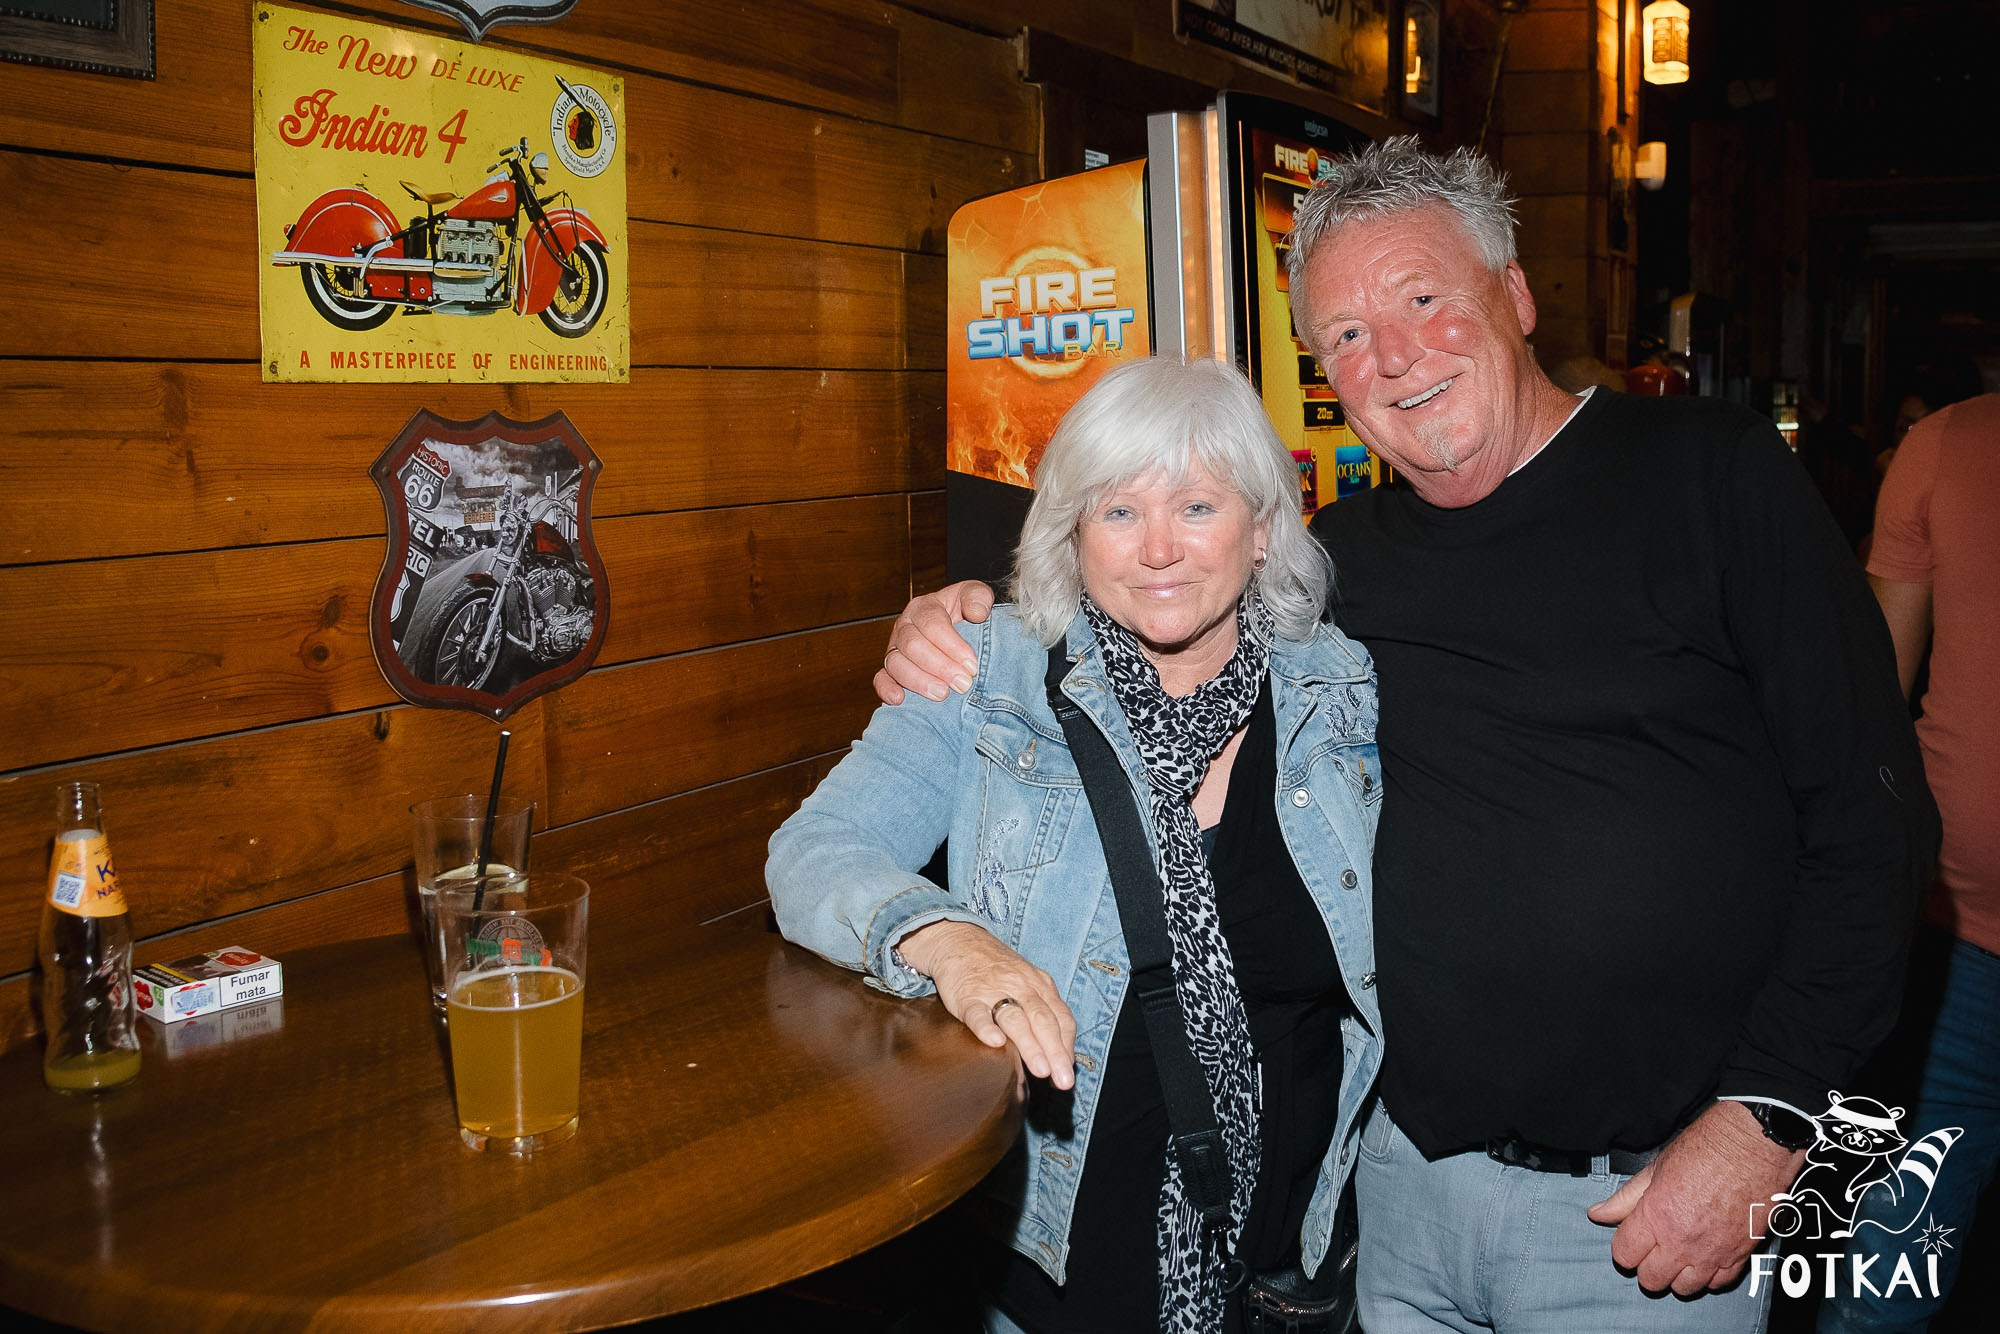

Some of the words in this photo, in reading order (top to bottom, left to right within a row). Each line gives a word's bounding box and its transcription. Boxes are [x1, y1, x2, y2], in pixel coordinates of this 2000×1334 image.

[283, 26, 329, 55] The
[337, 34, 417, 80] New
[466, 66, 525, 93] LUXE
[278, 89, 428, 158] Indian
[437, 108, 469, 164] 4
[1274, 143, 1309, 176] FIRE
[978, 267, 1118, 317] FIRE
[967, 308, 1135, 360] SHOT
[299, 351, 311, 369] A
[330, 351, 456, 370] MASTERPIECE
[473, 353, 493, 370] OF
[510, 355, 607, 372] ENGINEERING
[1063, 340, 1121, 360] BAR
[412, 462, 441, 487] ROUTE
[416, 447, 448, 475] HISTORIC
[404, 474, 435, 508] 66
[230, 970, 270, 988] Fumar
[236, 986, 266, 1001] mata
